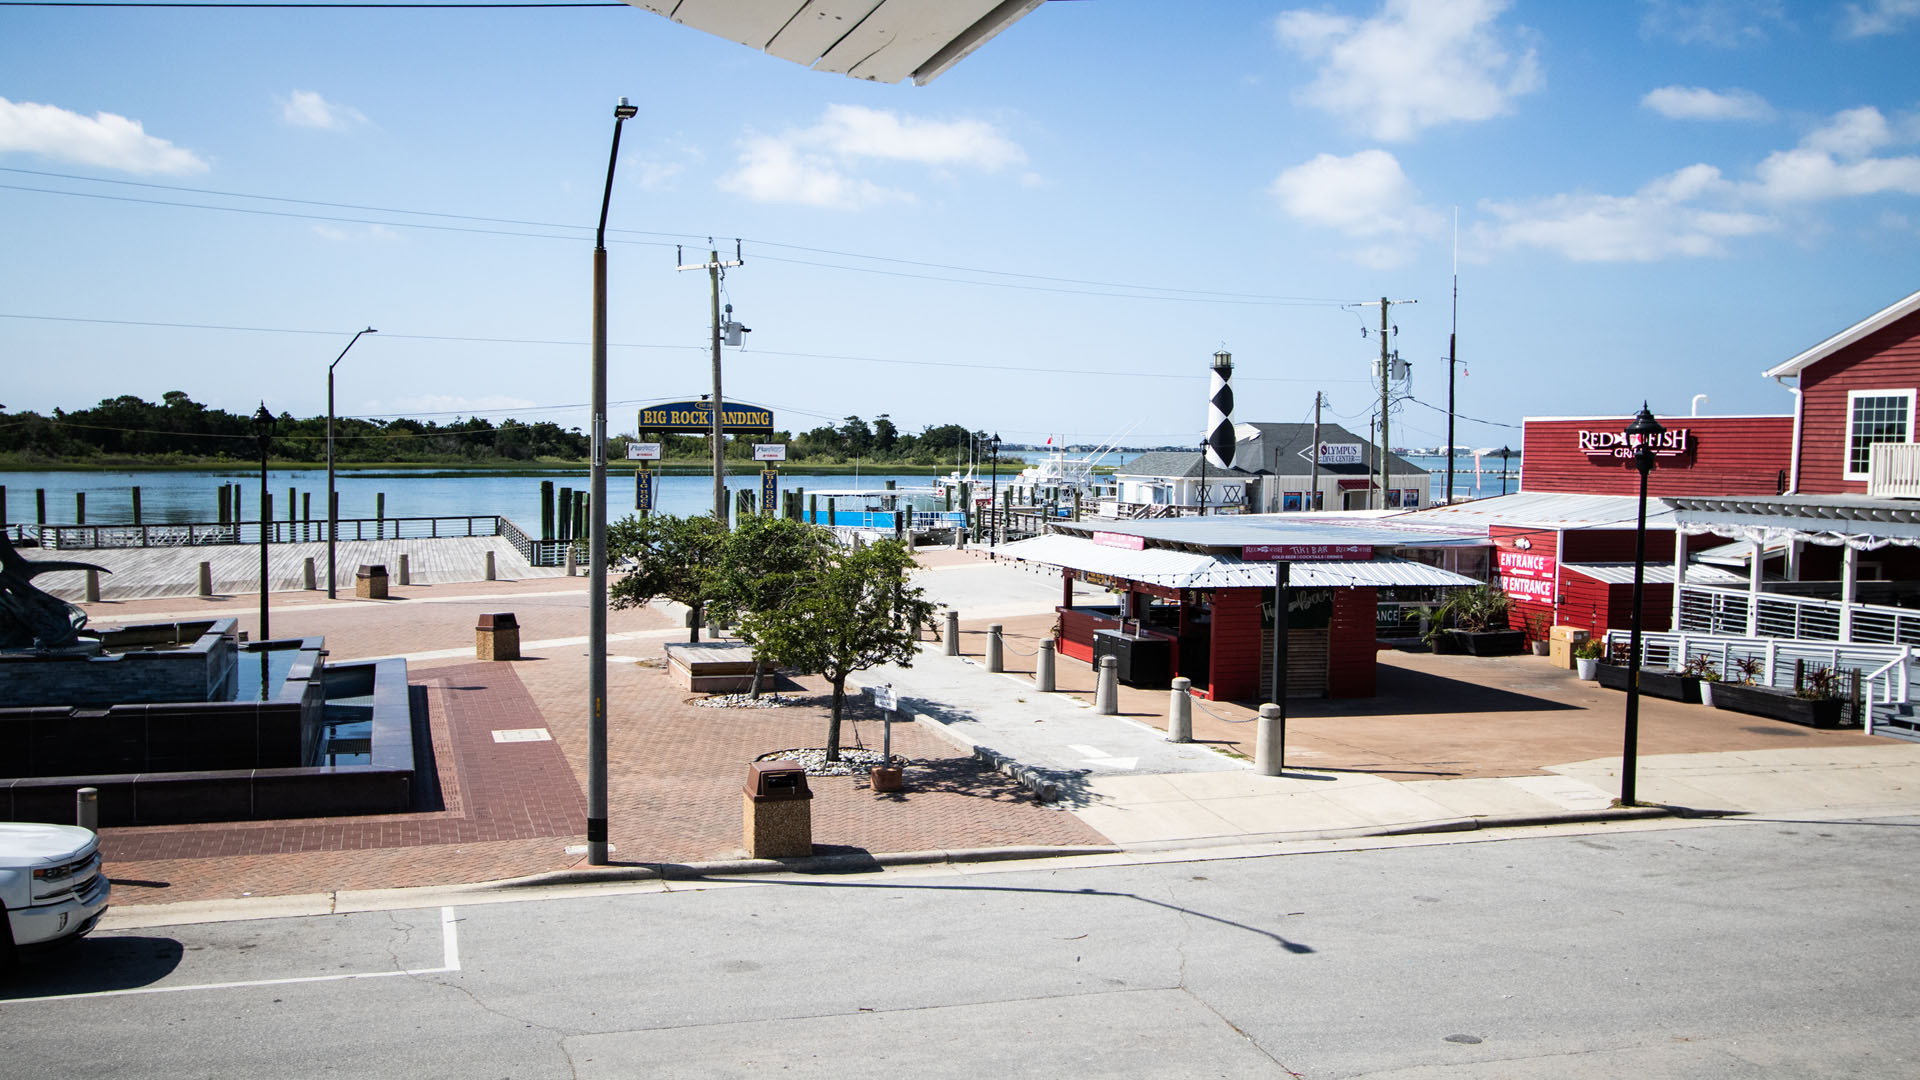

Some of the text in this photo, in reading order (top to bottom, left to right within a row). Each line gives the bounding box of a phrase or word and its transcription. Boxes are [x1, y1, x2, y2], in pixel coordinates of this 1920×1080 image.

[643, 411, 770, 425] BIG ROCK ANDING
[1578, 429, 1687, 450] RED FISH
[1321, 445, 1357, 456] OLYMPUS
[1322, 455, 1355, 463] DIVE CENTER
[640, 474, 648, 488] BIG
[1311, 546, 1328, 554] BAR
[1501, 553, 1545, 570] ENTRANCE
[1493, 576, 1552, 596] BAR ENTRANCE
